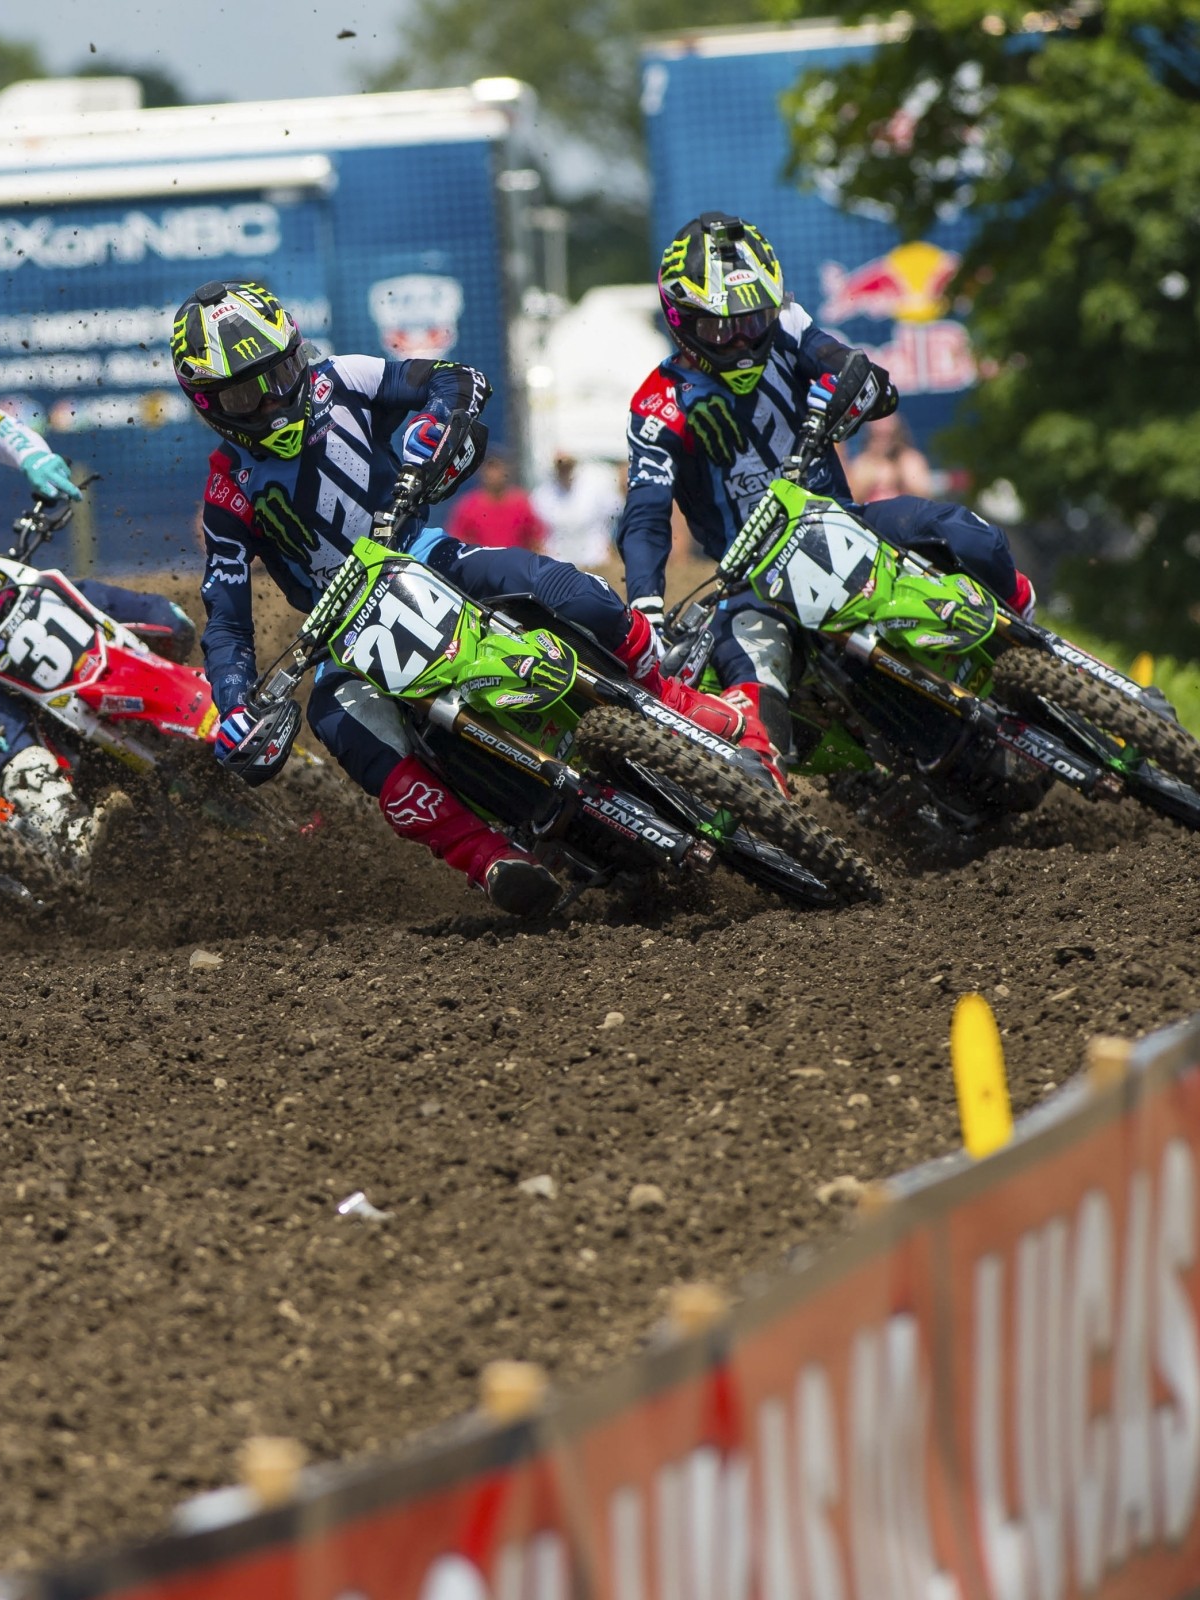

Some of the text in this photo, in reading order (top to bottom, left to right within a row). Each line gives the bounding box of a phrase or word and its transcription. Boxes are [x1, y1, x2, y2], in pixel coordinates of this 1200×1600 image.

[729, 272, 752, 282] BELL
[211, 303, 238, 320] BELL
[316, 383, 331, 400] ELL
[272, 418, 287, 429] BELL
[775, 523, 811, 571] LUCAS OIL
[787, 502, 880, 630] 44
[352, 580, 391, 633] LUCAS OIL
[354, 561, 464, 695] 214
[7, 588, 95, 690] 31
[463, 723, 541, 772] PRO CIRCU
[643, 704, 738, 760] DUNLOP
[998, 731, 1086, 781] DUNLOP
[583, 796, 677, 849] DUNLOP
[612, 795, 644, 815] TECH
